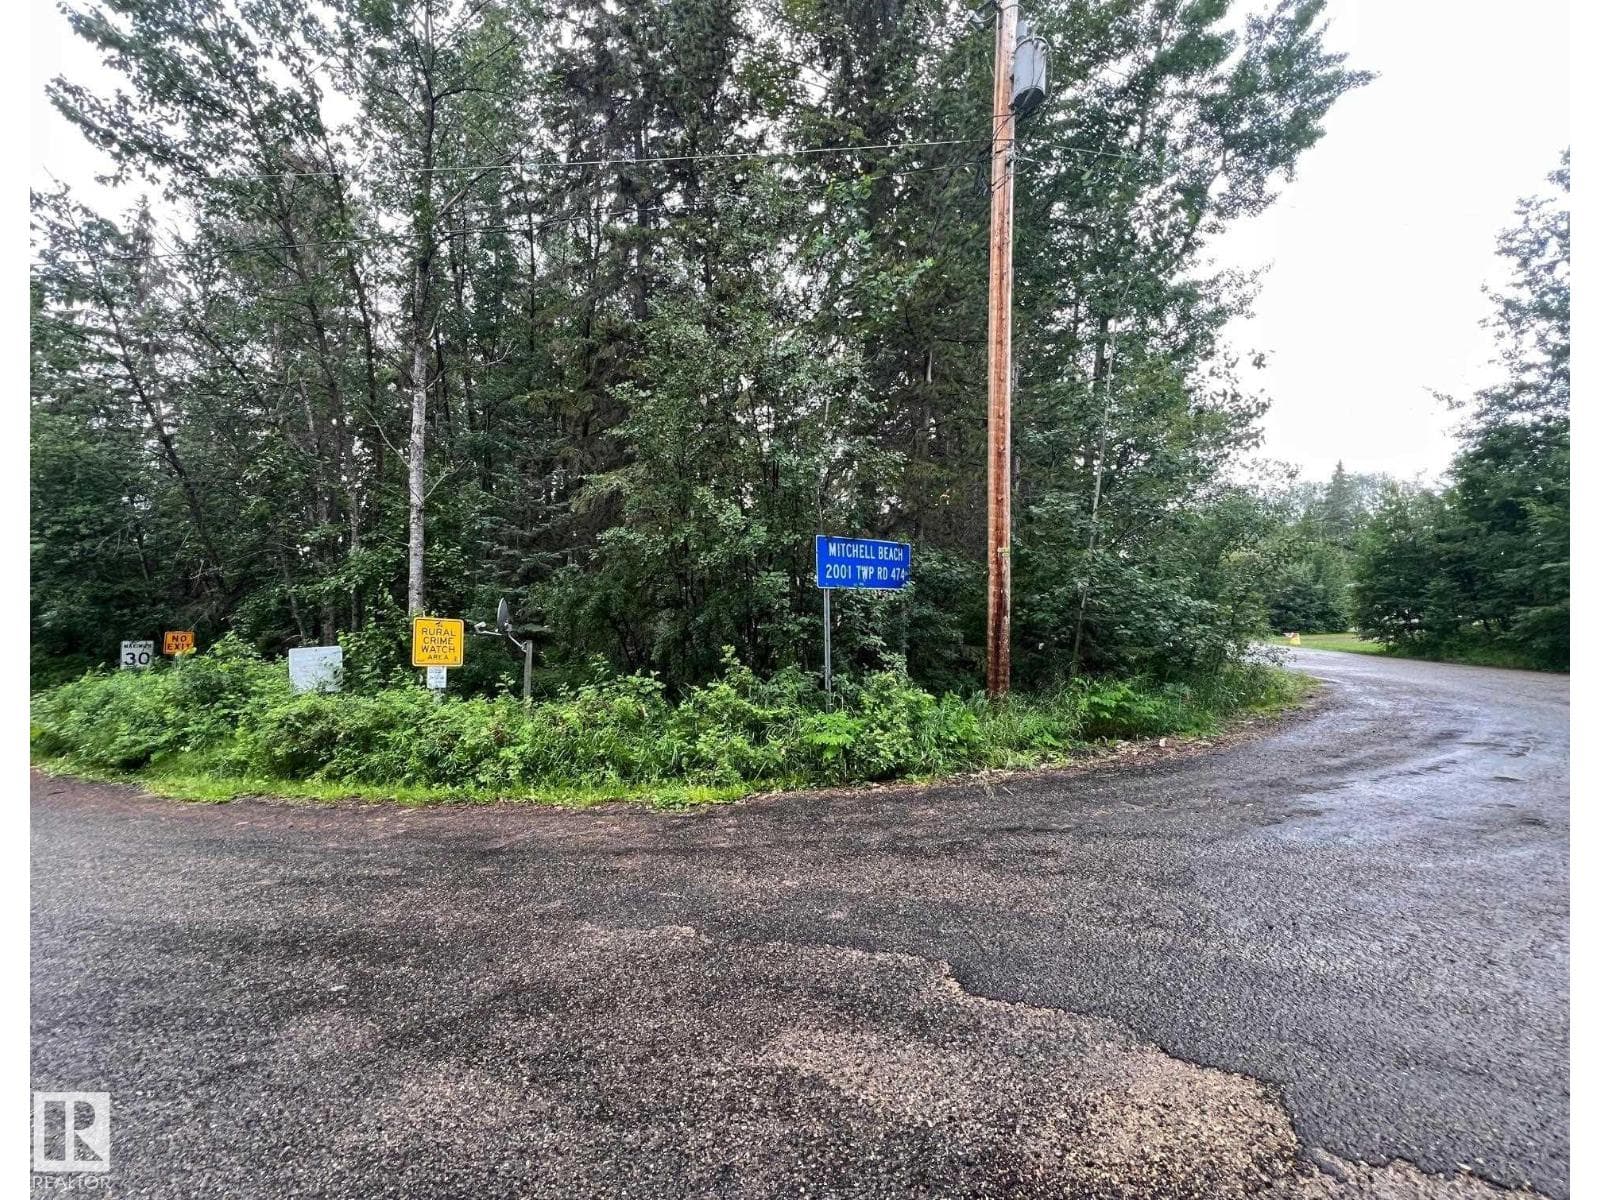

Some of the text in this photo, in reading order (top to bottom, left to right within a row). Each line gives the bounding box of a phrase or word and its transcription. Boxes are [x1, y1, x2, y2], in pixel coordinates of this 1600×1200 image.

[828, 542, 904, 562] MITCHELL BEACH
[825, 563, 905, 582] 2001 TWP RD 474
[421, 627, 457, 637] RURAL
[171, 635, 187, 643] NO
[422, 636, 455, 645] CRIME
[167, 643, 191, 651] EXIT
[421, 645, 455, 654] WATCH
[124, 652, 150, 666] 30
